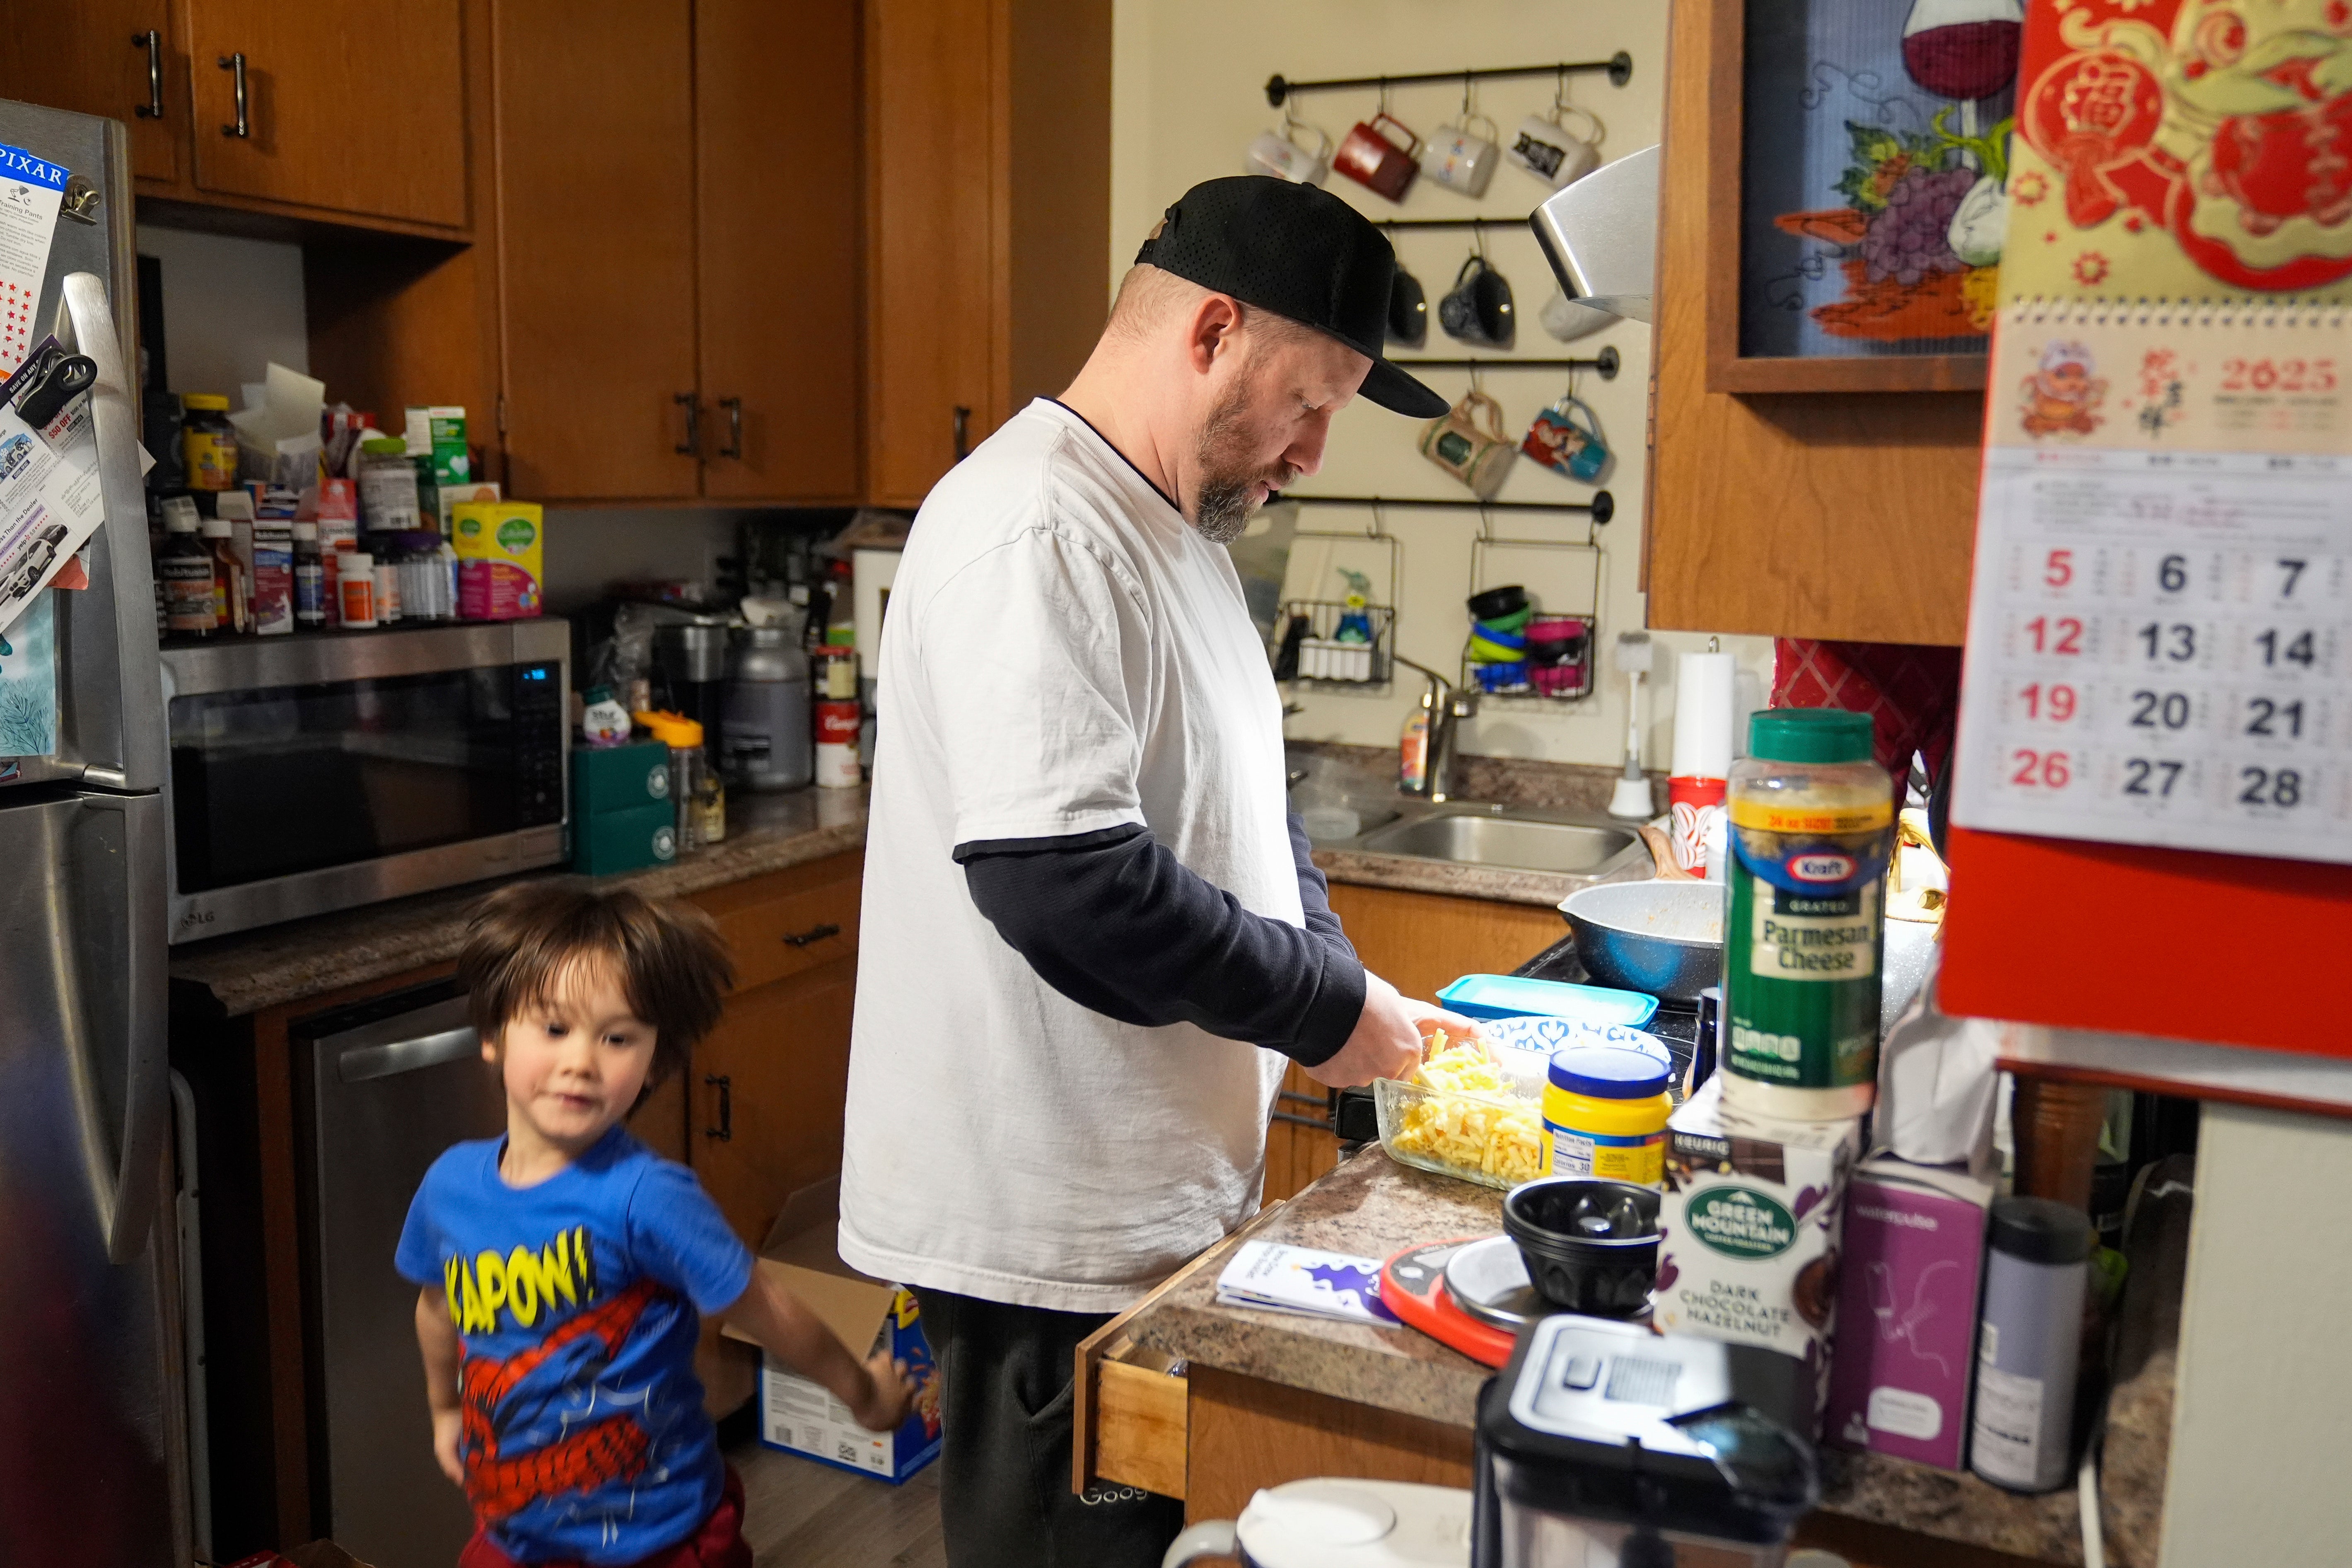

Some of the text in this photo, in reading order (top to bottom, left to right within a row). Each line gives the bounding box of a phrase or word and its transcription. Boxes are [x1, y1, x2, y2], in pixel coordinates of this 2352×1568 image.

[0, 148, 61, 185] PIXAR
[0, 200, 42, 220] Training Pants
[9, 364, 36, 393] SAVE ON ANY
[48, 425, 61, 440] $50
[60, 413, 72, 428] OFF
[4, 522, 17, 536] Than
[15, 515, 24, 524] the
[22, 498, 38, 515] Dealer
[17, 539, 27, 551] yelp
[2045, 551, 2308, 597] 5 6 7
[2027, 616, 2316, 669] 12 13 14
[2019, 683, 2304, 738] 19 20 21
[2011, 749, 2302, 808] 26 27 28
[1802, 857, 1842, 874] Kraft
[1789, 898, 1847, 912] GRATED
[1764, 919, 1871, 945] Parmesan
[1777, 947, 1854, 969] Cheese
[1554, 1131, 1592, 1147] Nutrition Facts
[1674, 1135, 1730, 1156] KEURIG
[1553, 1157, 1575, 1169] Calories
[1706, 1200, 1774, 1224] GREEN
[1691, 1213, 1790, 1243] MOUNTAIN
[443, 1224, 594, 1336] KAPOW!
[1710, 1279, 1760, 1300] DARK
[1679, 1289, 1790, 1323] CHOCOLATE
[1687, 1308, 1781, 1337] HAZELNUT
